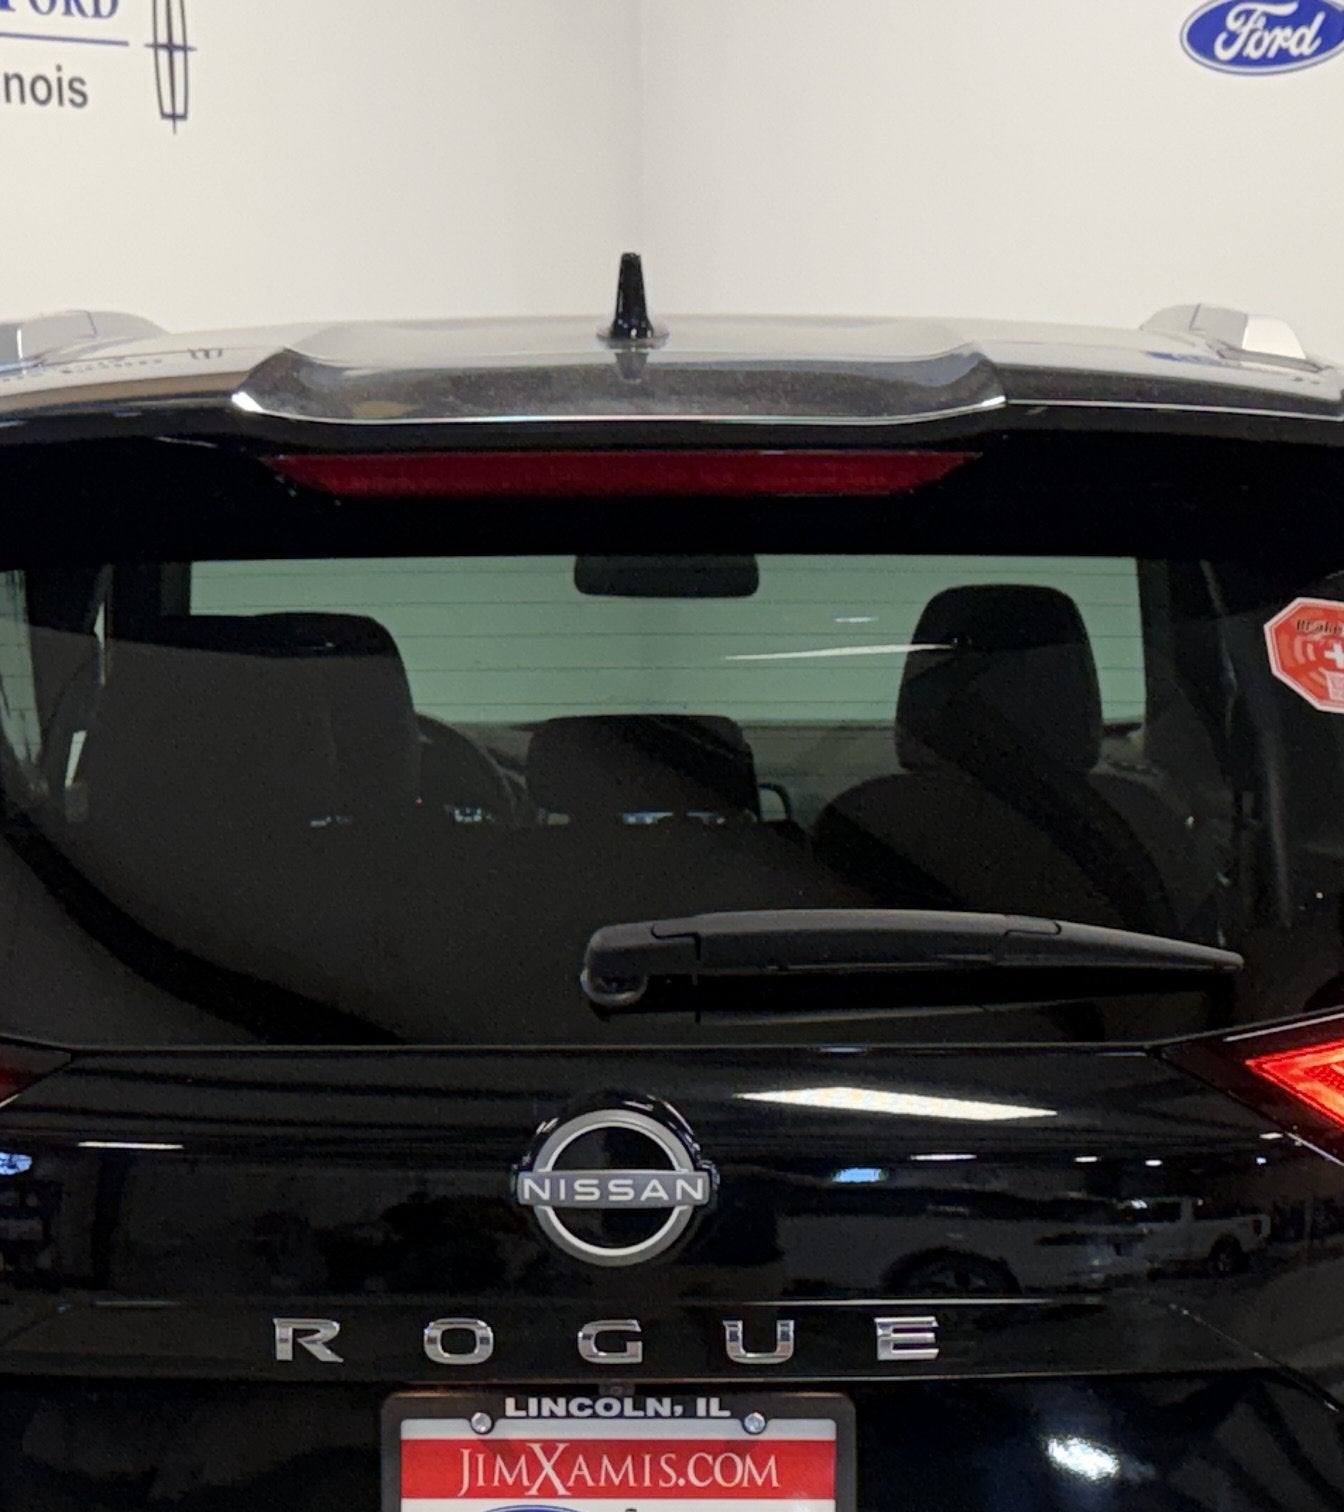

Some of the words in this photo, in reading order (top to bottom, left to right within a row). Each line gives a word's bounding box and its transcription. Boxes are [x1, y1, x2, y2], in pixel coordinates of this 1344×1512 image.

[1213, 2, 1326, 61] Ford
[523, 1177, 704, 1202] NISSAN
[273, 1316, 940, 1365] ROGUE
[505, 1397, 684, 1417] LINCOLN,
[696, 1397, 732, 1416] IL
